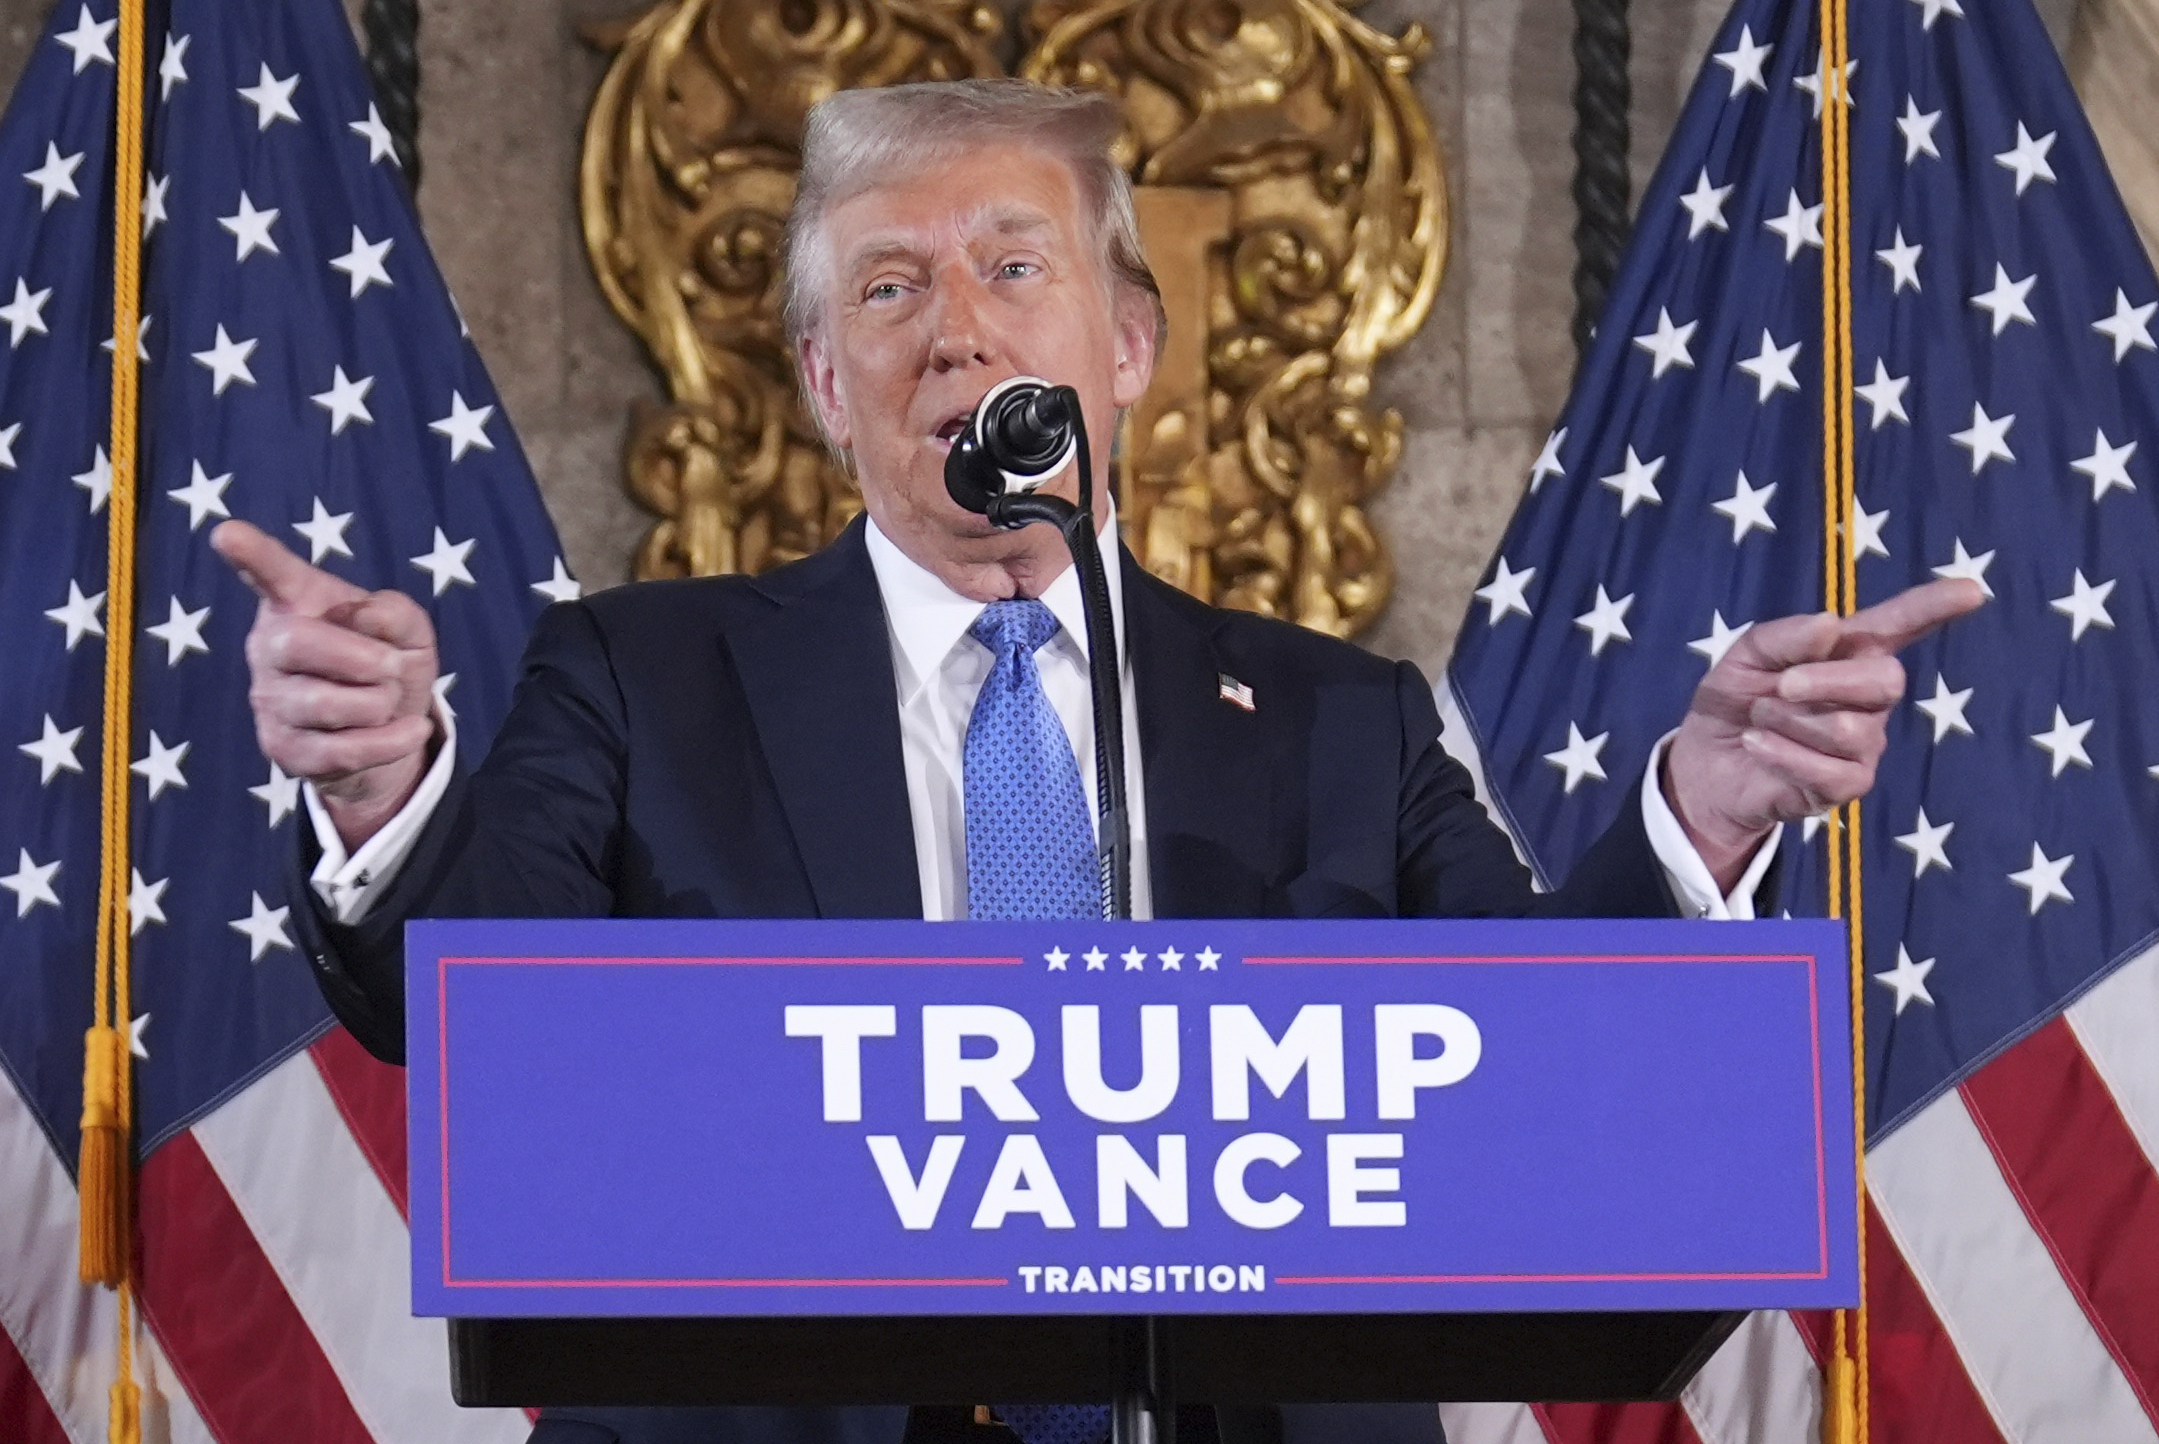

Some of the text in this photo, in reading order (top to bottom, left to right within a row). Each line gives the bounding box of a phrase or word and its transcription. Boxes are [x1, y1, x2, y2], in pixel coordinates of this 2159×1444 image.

[784, 1004, 1483, 1124] TRUMP
[865, 1132, 1407, 1231] VANCE
[1017, 1264, 1266, 1294] TRANSITION
